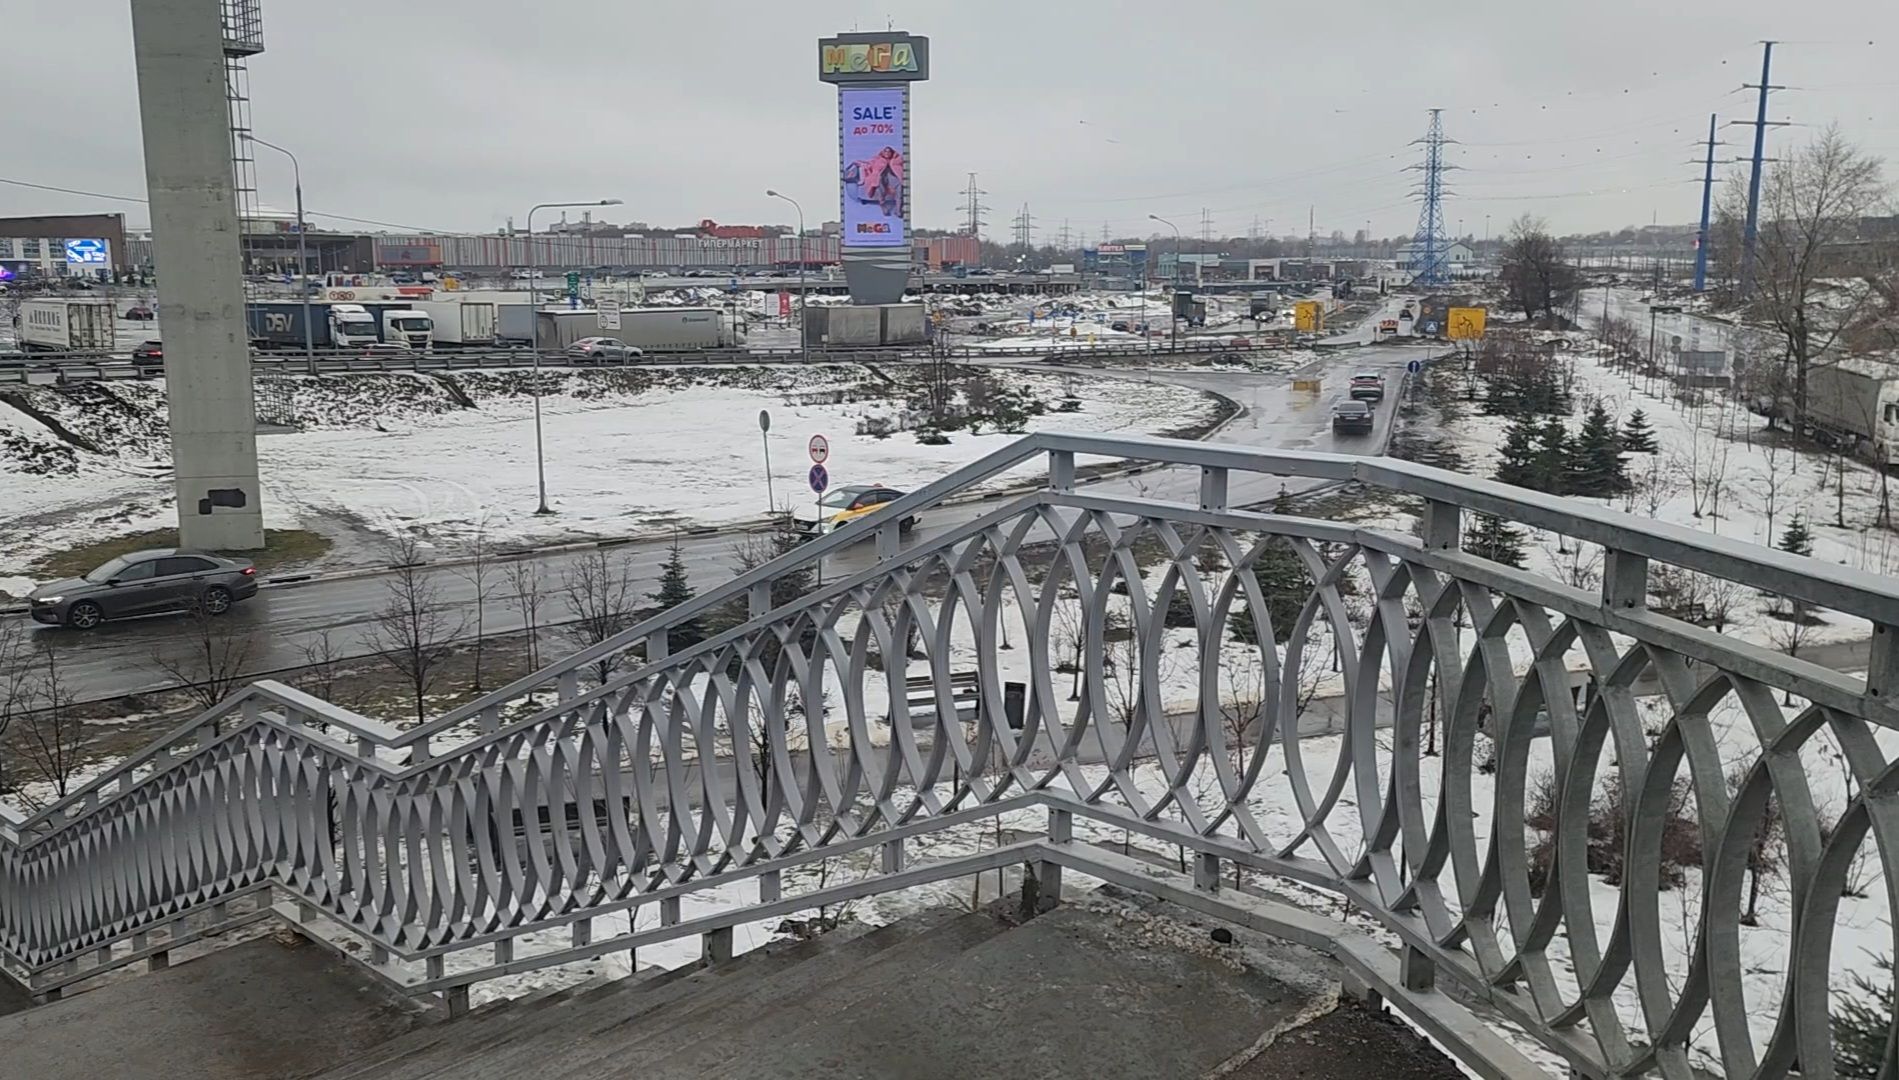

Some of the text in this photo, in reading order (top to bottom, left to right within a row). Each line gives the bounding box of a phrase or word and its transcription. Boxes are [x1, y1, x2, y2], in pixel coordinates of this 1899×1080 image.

[853, 124, 894, 135] до 70%
[698, 239, 763, 249] ГИПЕРМАРКЕТ
[265, 313, 293, 332] DSV
